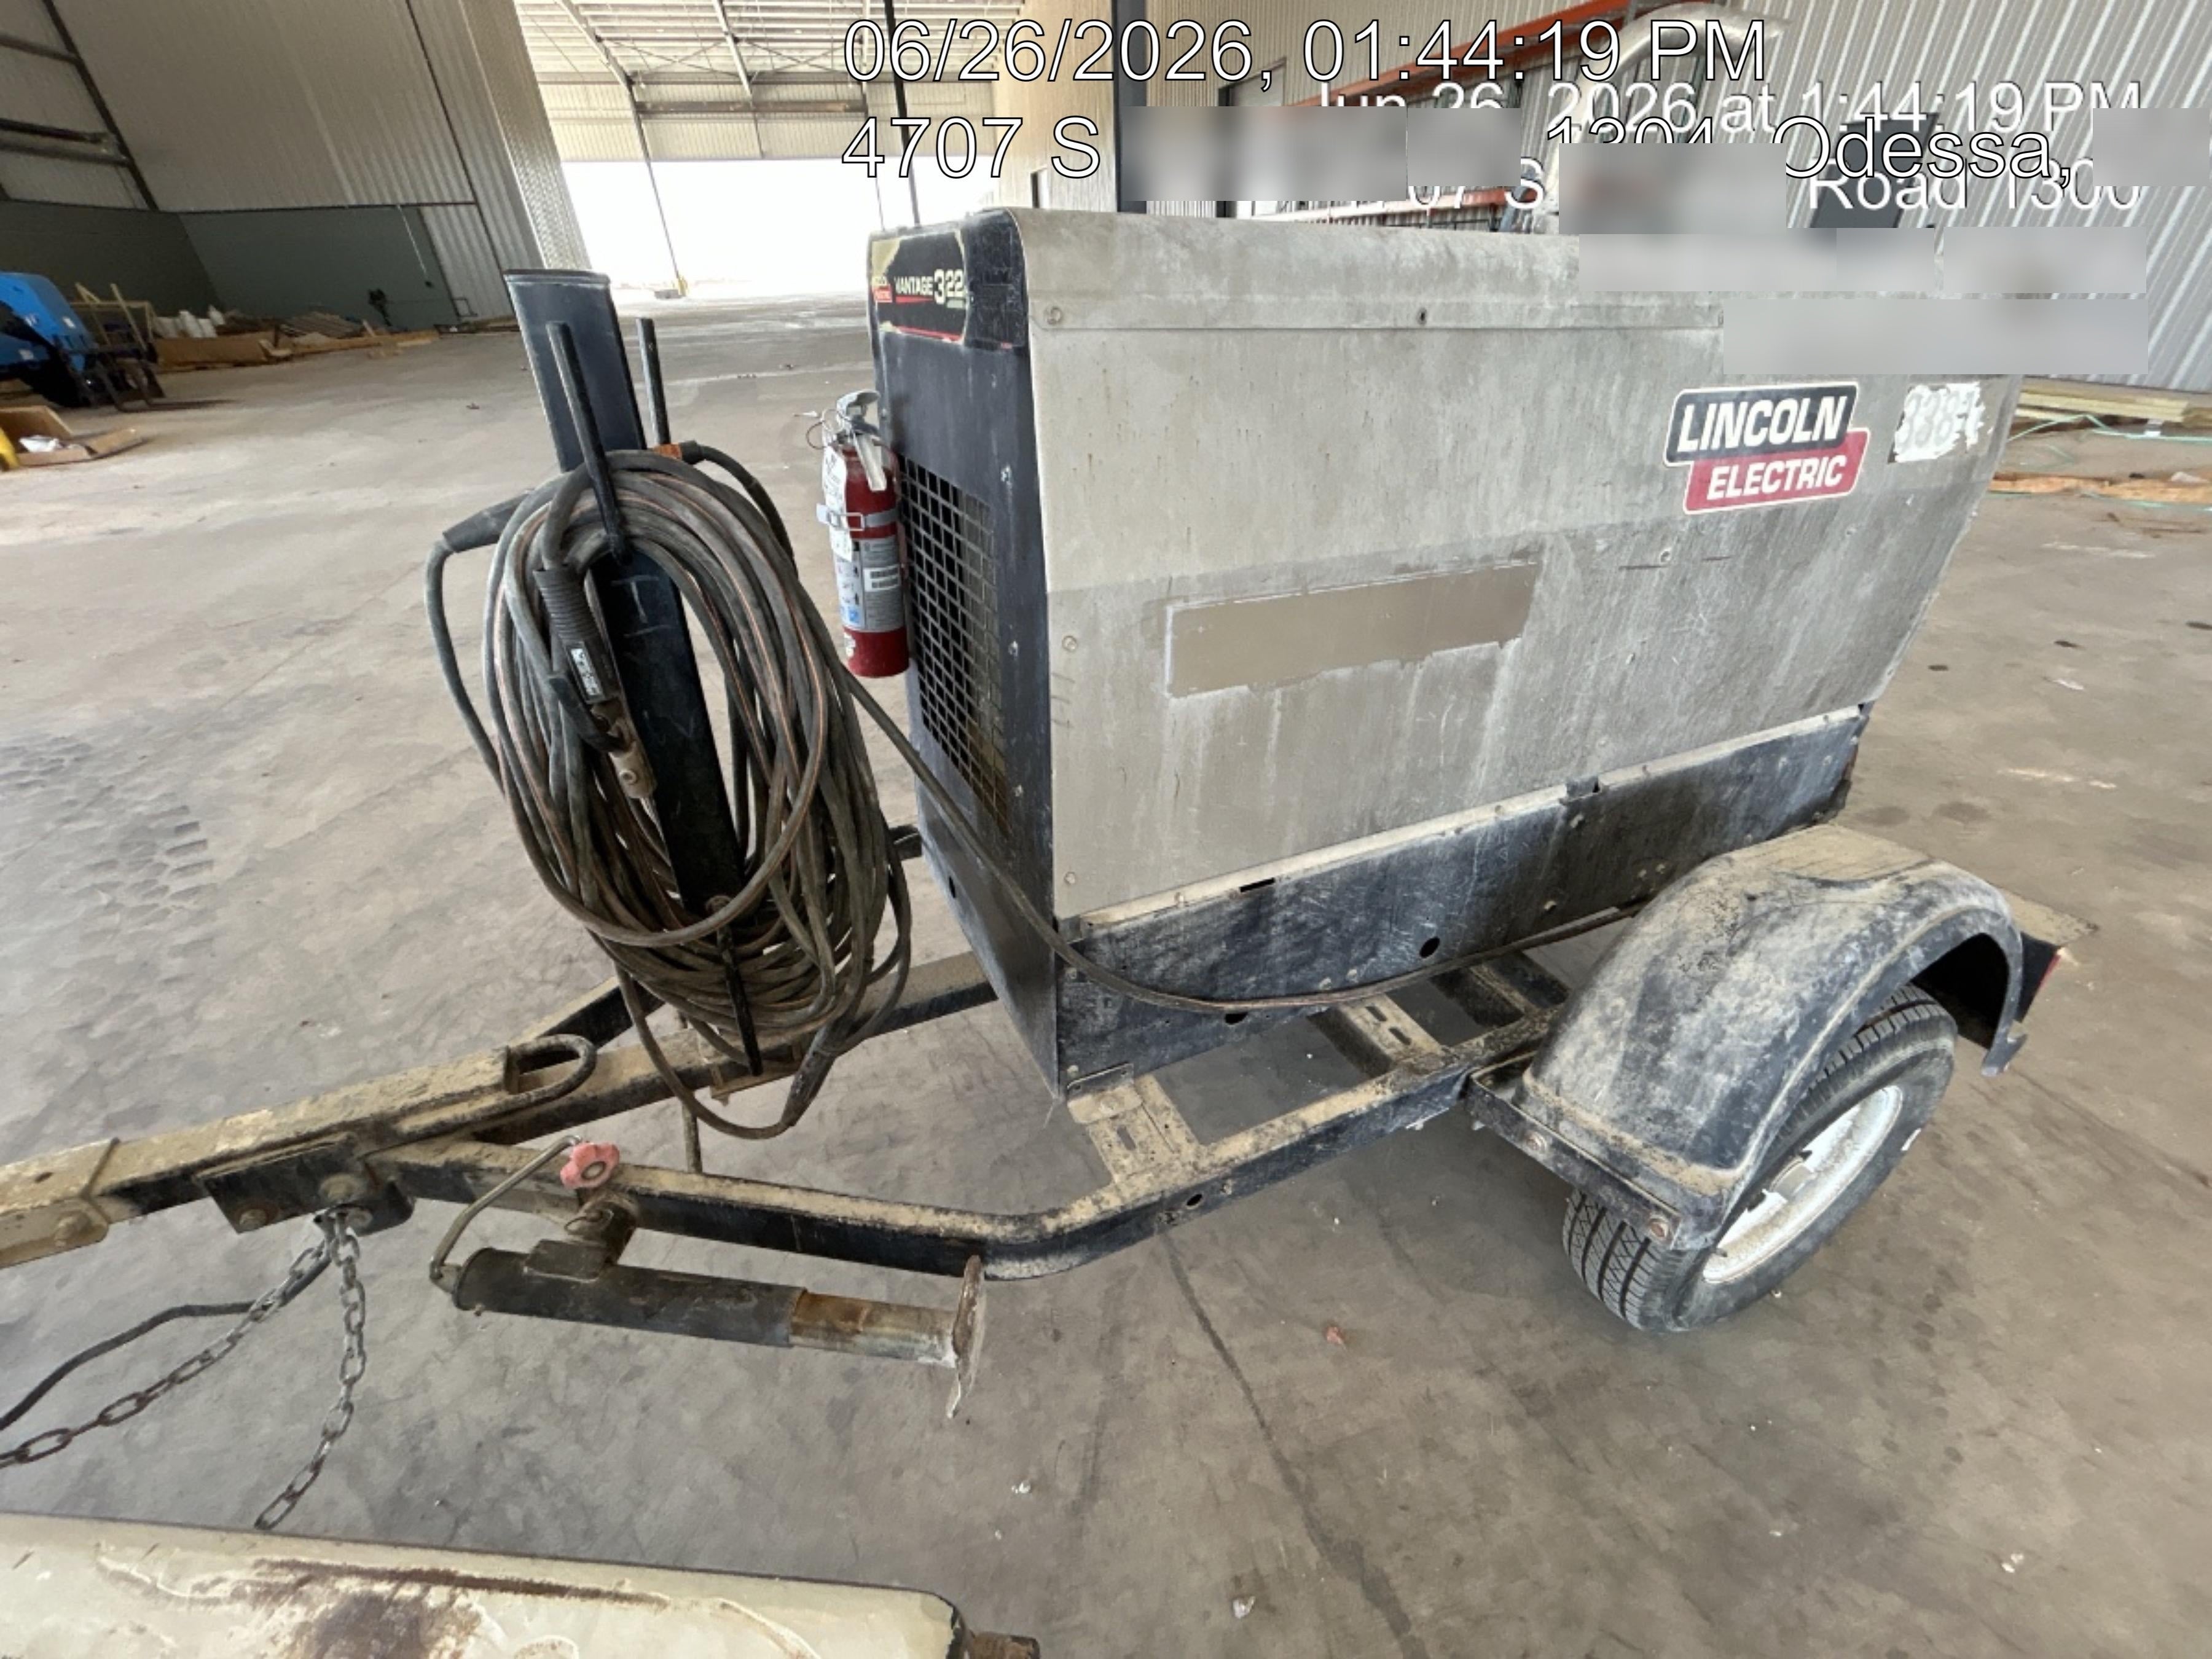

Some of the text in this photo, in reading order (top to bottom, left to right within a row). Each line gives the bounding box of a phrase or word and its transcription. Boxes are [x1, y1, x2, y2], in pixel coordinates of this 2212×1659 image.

[933, 269, 965, 305] 322
[1676, 396, 1847, 453] LINCOLN
[1706, 455, 1847, 500] ELECTRIC
